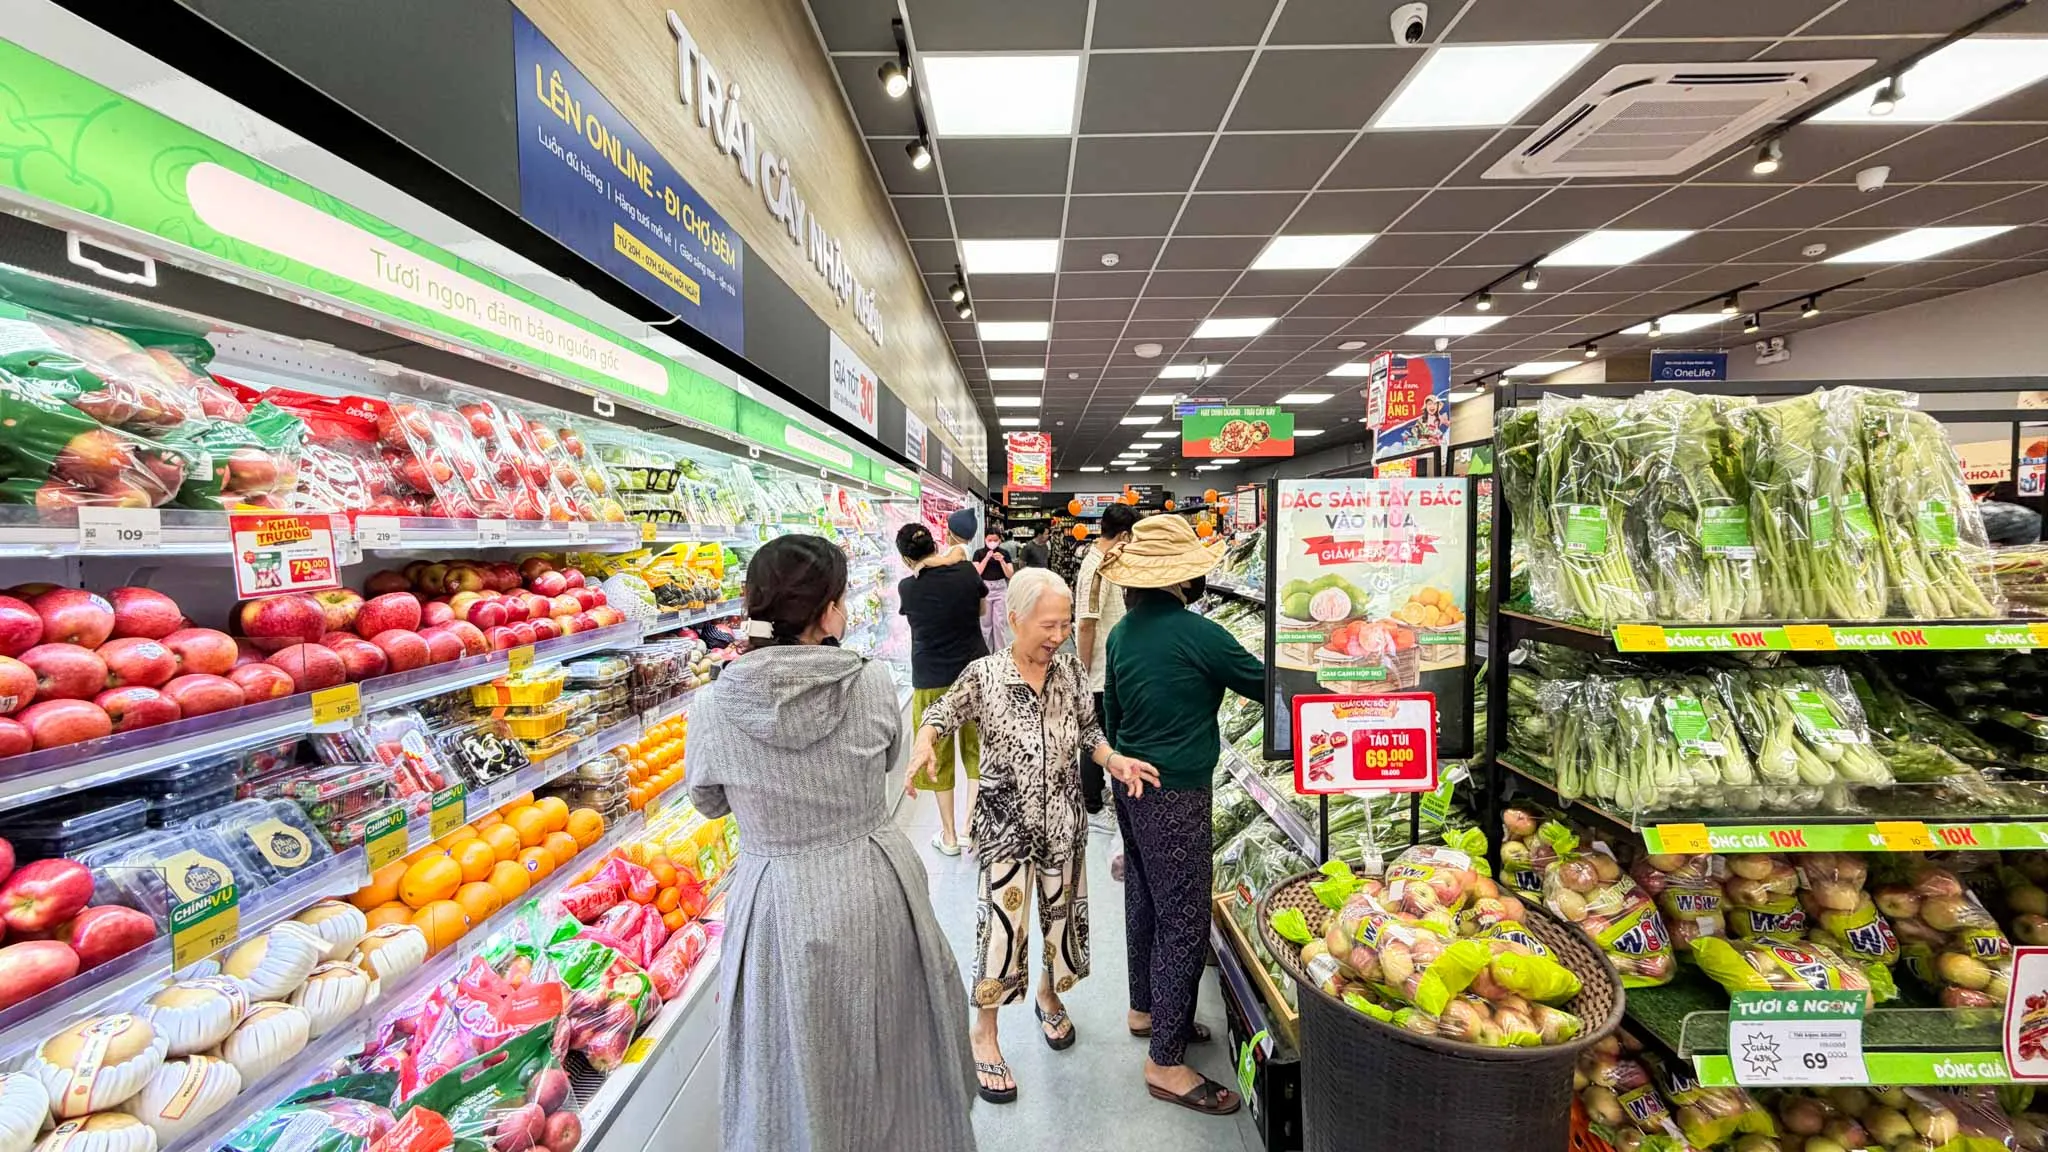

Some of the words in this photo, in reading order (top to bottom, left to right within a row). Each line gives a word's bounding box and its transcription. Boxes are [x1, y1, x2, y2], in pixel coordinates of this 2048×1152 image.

[536, 63, 582, 134] LÊN
[586, 114, 653, 198] ONLINE
[664, 186, 680, 222] ĐI
[683, 204, 711, 252] CHỢ
[711, 230, 736, 271] ĐÊM
[538, 126, 564, 161] Luôn
[566, 151, 579, 173] đủ
[580, 162, 604, 195] hàng
[615, 190, 635, 221] Hàng
[680, 244, 693, 263] Giao
[760, 152, 805, 245] CÂY
[808, 212, 853, 309] NHẬP
[628, 244, 641, 260] 20H
[658, 263, 673, 282] SÁNG
[370, 247, 421, 293] Tươi
[428, 276, 482, 320] ngon,
[487, 301, 523, 334] đảm
[528, 315, 554, 346] bảo
[558, 333, 597, 362] nguồn
[600, 349, 620, 371] gốc
[834, 359, 846, 386] GIÁ
[1674, 368, 1716, 378] OneLife?
[1390, 390, 1404, 402] UA
[1408, 390, 1415, 402] 2
[1412, 404, 1416, 416] 1
[1420, 483, 1462, 506] BẮC
[268, 519, 298, 531] KHAI
[1325, 510, 1364, 529] VÀO
[117, 529, 143, 541] 109
[257, 528, 310, 544] TRƯƠNG
[377, 532, 390, 541] 219
[1322, 546, 1354, 561] GIẢM
[1707, 633, 1731, 648] GIÁ
[1732, 631, 1767, 647] 10K
[1834, 630, 1865, 646] ỒNG
[1866, 631, 1892, 646] GIÁ
[1892, 629, 1928, 647] 10K
[1985, 629, 2026, 645] ĐỒNG
[336, 704, 351, 714] 169
[1369, 732, 1389, 747] TÁO
[1391, 731, 1409, 746] TÚI
[1365, 748, 1414, 768] 69.000
[367, 818, 390, 835] CHÍNH
[389, 811, 403, 826] VỤ
[1709, 830, 1741, 849] ỒNG
[1742, 832, 1769, 849] GIÁ
[1769, 829, 1807, 848] 10K
[1938, 827, 1978, 846] 10K
[188, 869, 214, 883] Blue
[174, 894, 212, 922] CHÍNH
[211, 886, 233, 907] VỤ
[210, 934, 226, 948] 119
[1738, 998, 1782, 1016] TƯƠI
[1786, 1000, 1799, 1013] &
[1803, 999, 1857, 1015] NGON
[1751, 1043, 1772, 1052] GIẢM
[1754, 1055, 1772, 1063] 43%
[1803, 1052, 1828, 1069] 69
[1933, 1057, 1978, 1079] ĐỒNG
[1978, 1059, 2008, 1078] GIÁ
